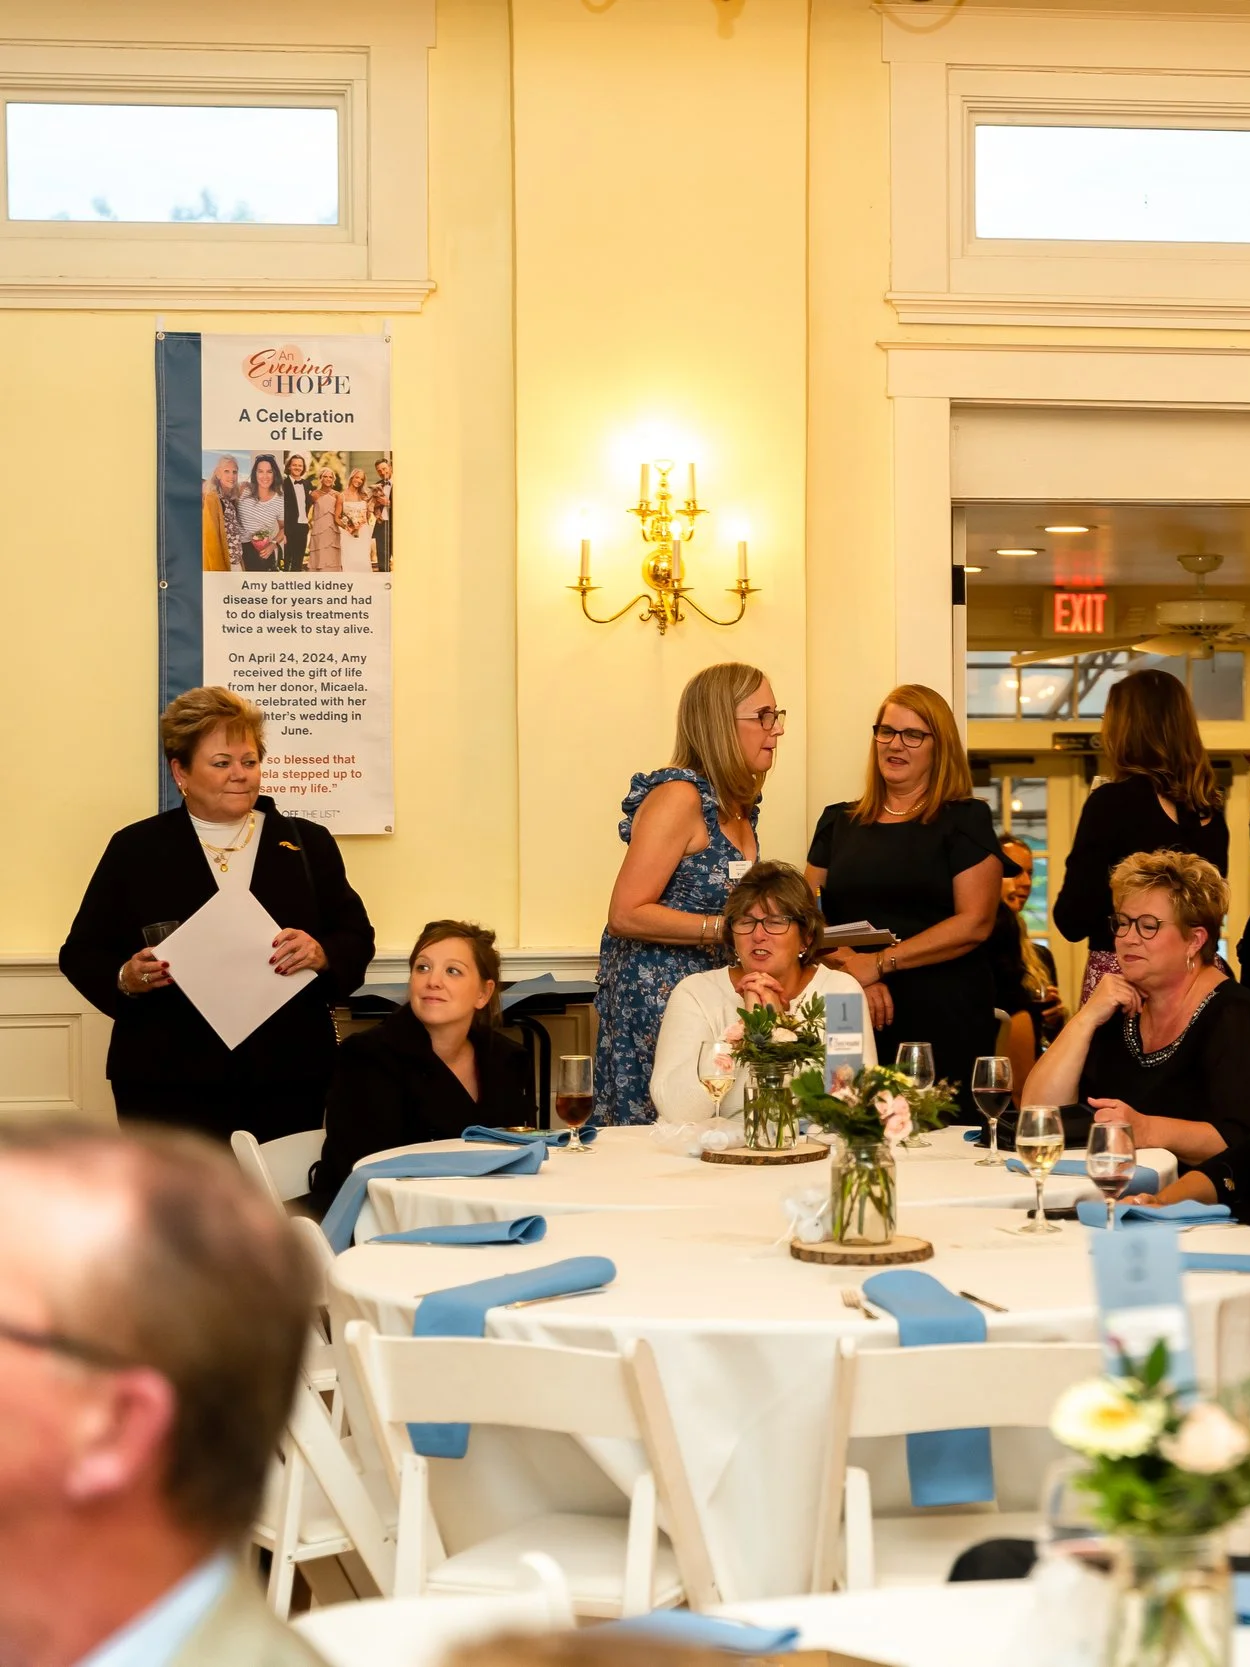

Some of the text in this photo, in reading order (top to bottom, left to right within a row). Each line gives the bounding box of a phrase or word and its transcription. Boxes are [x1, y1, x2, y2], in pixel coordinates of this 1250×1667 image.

[279, 350, 294, 361] An
[248, 348, 334, 387] Evening
[262, 374, 350, 394] of HOPE
[239, 408, 354, 424] A Celebration
[270, 427, 323, 441] of Life
[241, 580, 354, 592] Amy battled kidney
[223, 594, 372, 607] disease for years and had
[226, 609, 369, 622] to do dialysis treatments
[1053, 592, 1107, 634] EXIT
[222, 624, 374, 637] twice a week to stay alive.
[228, 652, 367, 666] On April 24, 2024, Amy
[233, 667, 362, 680] received the gift of life
[228, 682, 368, 693] from her donor, Micaela.
[255, 697, 317, 706] celebrated
[320, 697, 344, 706] with
[347, 697, 366, 706] her
[263, 711, 362, 723] hter’s wedding in
[281, 726, 313, 736] June.
[266, 755, 356, 765] so blessed that
[282, 769, 330, 781] stepped
[333, 771, 347, 782] up
[350, 769, 362, 779] to
[260, 785, 286, 793] save
[289, 785, 307, 796] my
[302, 810, 317, 818] THE
[841, 1001, 848, 1021] 1
